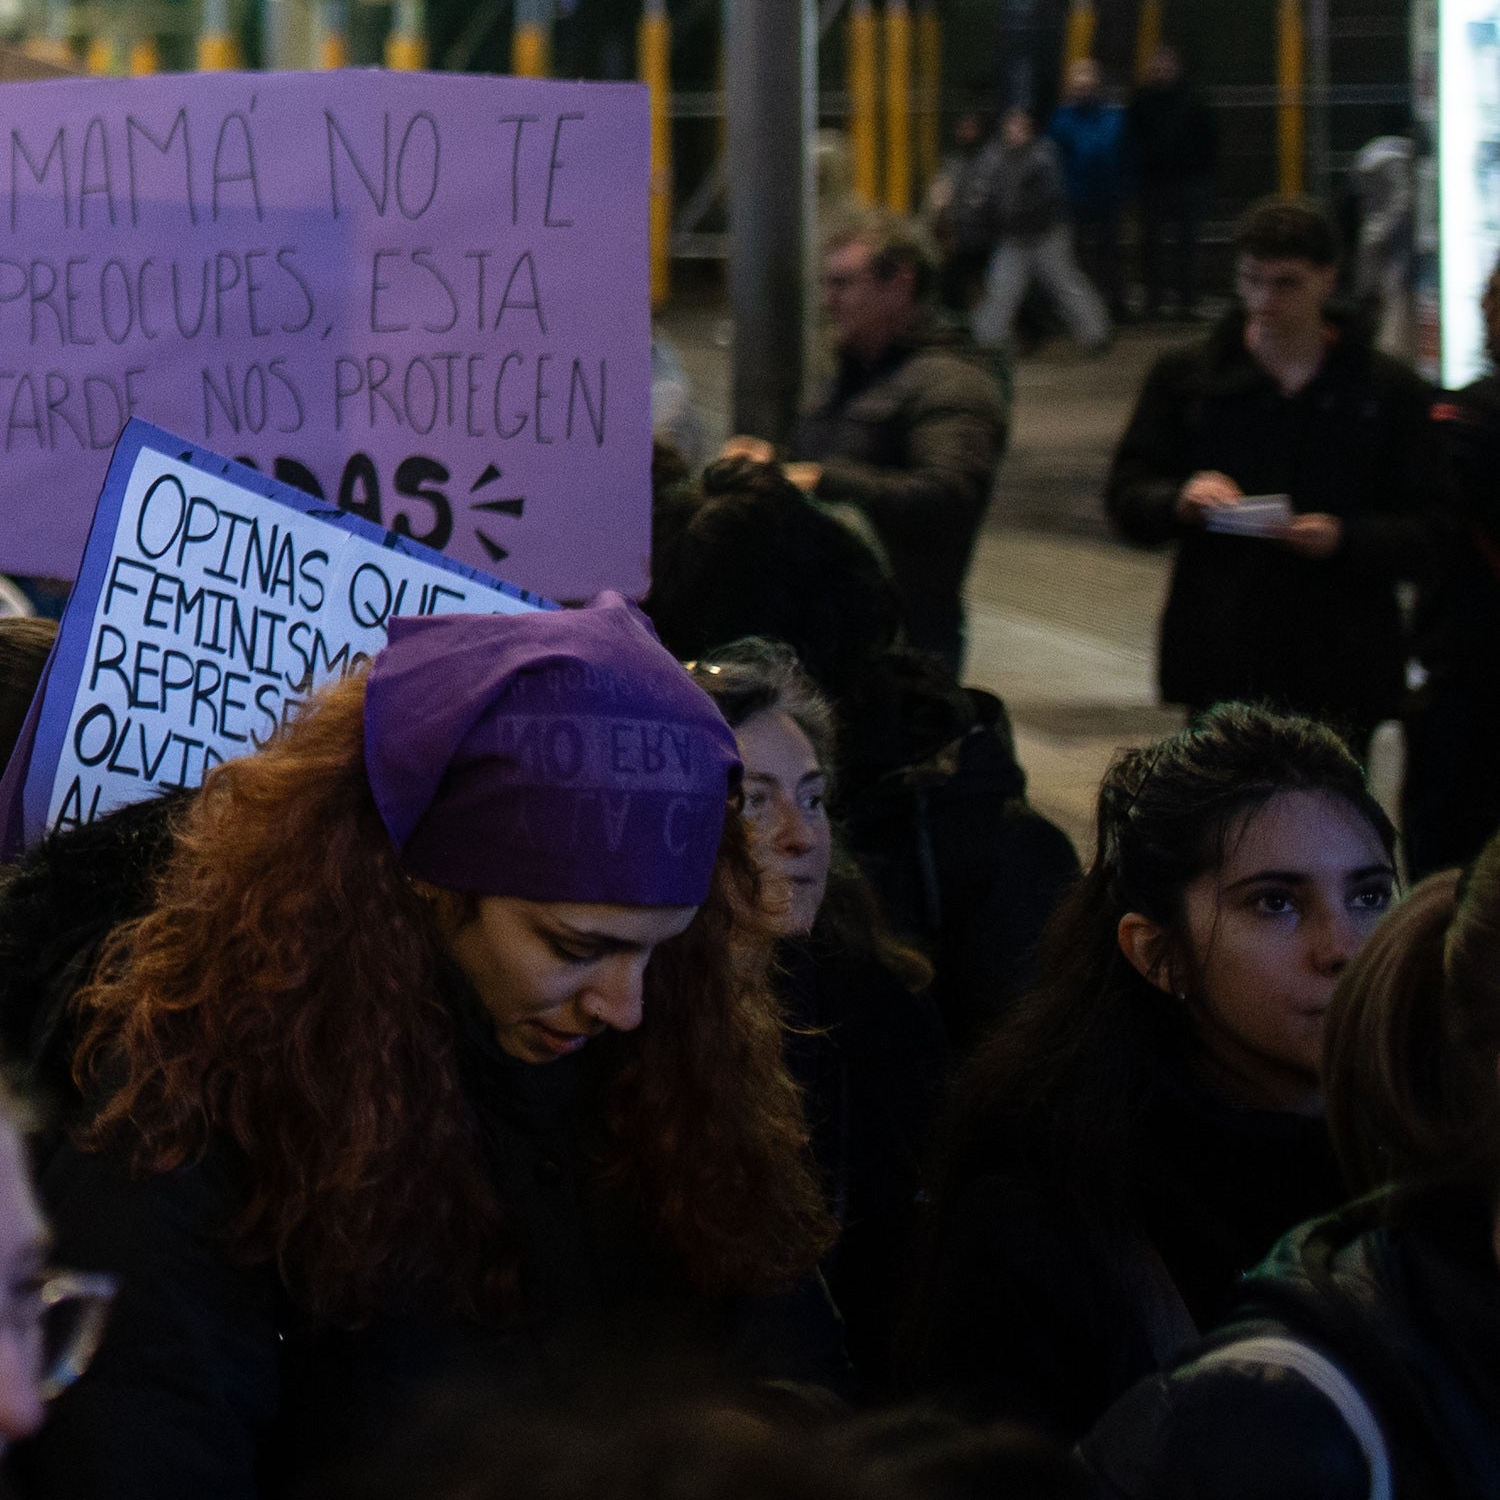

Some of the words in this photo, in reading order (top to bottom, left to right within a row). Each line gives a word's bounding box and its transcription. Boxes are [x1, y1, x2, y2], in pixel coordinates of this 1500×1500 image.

[10, 91, 265, 233] MAMÁ
[323, 107, 442, 222] NO
[500, 110, 586, 229] TE
[369, 247, 549, 337] ESTA
[200, 356, 306, 440] NOS
[334, 349, 607, 449] PROTEGEN
[136, 473, 330, 614] OPINAS
